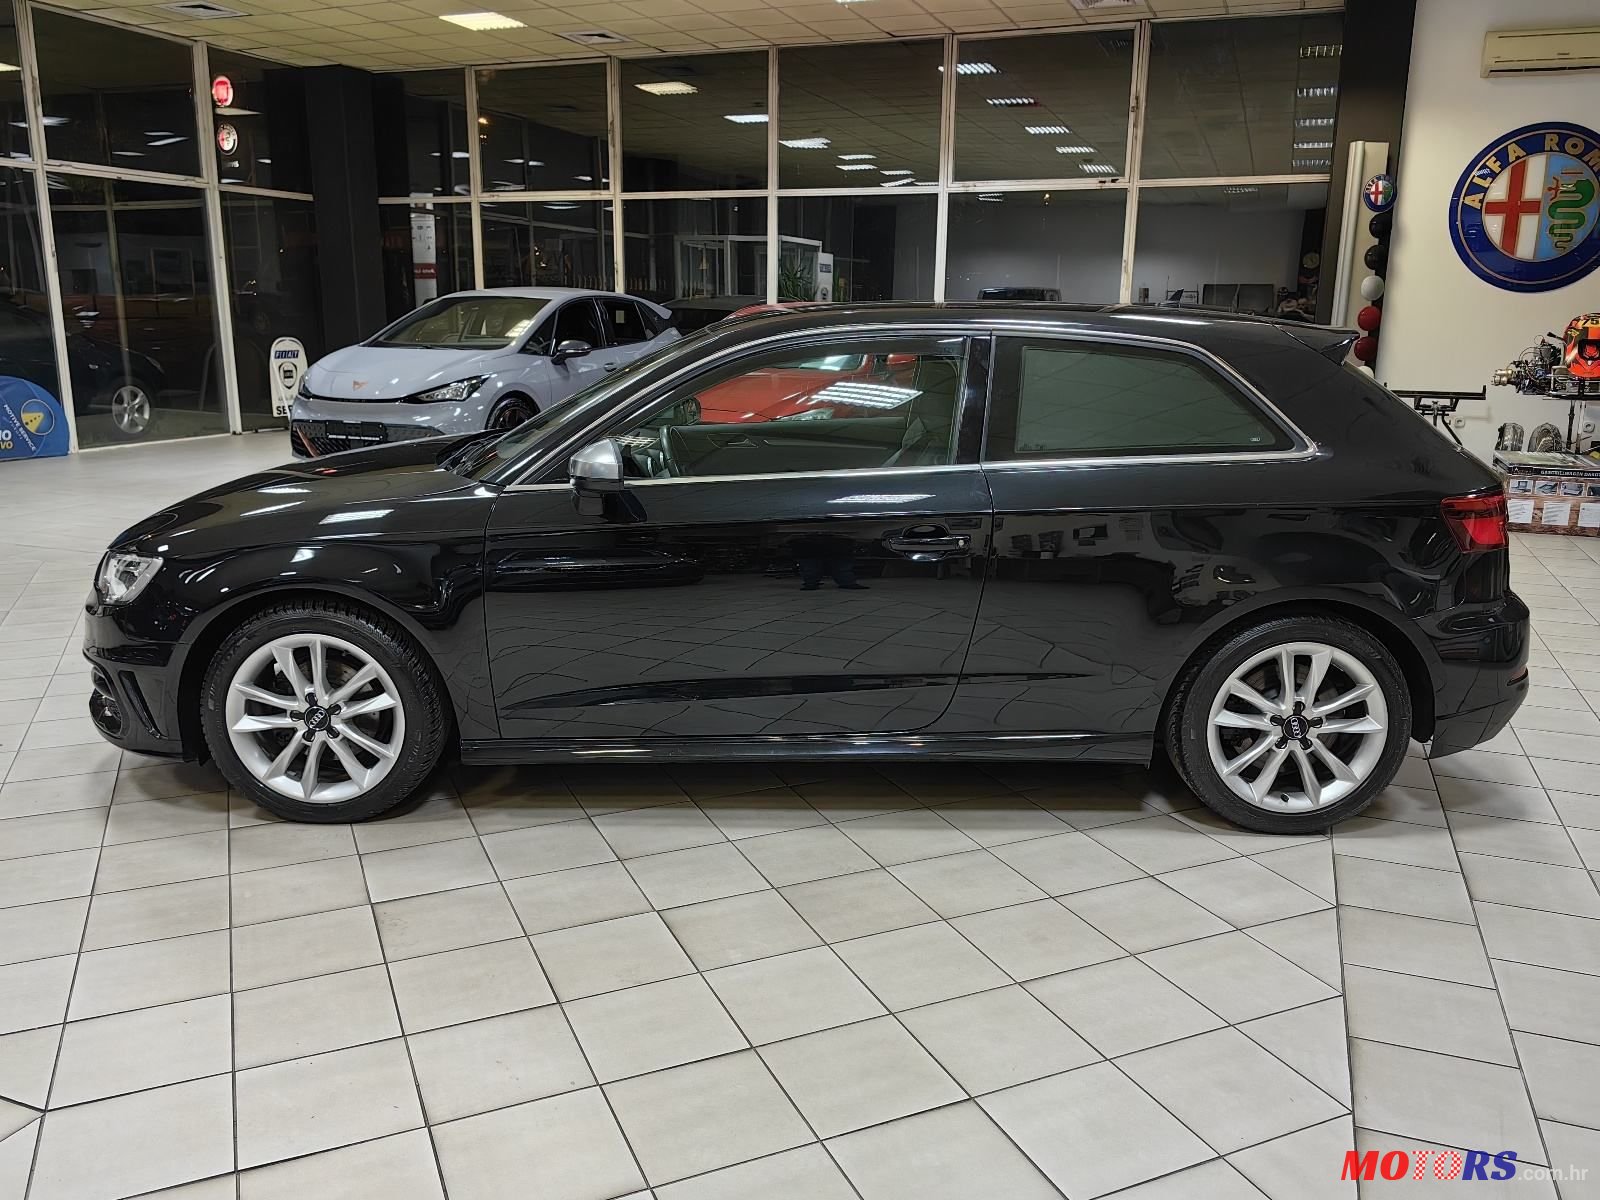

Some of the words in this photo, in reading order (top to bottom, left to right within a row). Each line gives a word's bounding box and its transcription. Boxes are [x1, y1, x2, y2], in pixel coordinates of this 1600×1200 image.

[1463, 142, 1527, 209] ALFA
[275, 350, 299, 359] FIAT
[4, 404, 21, 428] MOTIVE
[19, 427, 37, 452] SERVICE
